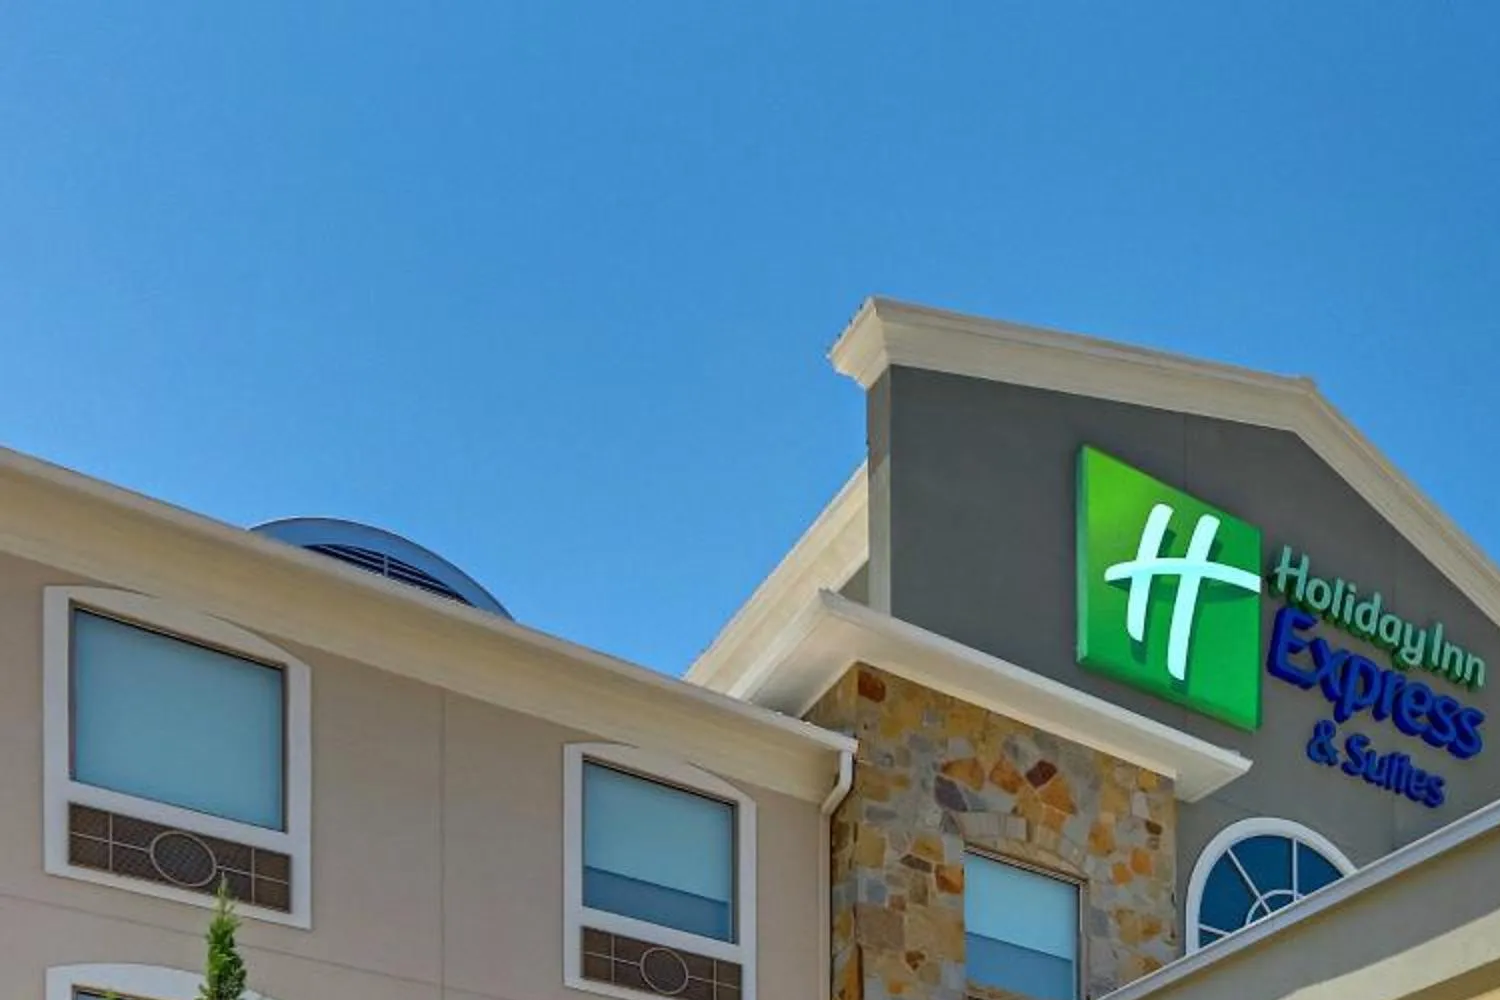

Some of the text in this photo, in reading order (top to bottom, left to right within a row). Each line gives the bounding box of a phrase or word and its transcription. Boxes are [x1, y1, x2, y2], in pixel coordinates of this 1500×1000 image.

[1267, 604, 1486, 760] Express
[1273, 545, 1487, 689] Holiday Inn
[1306, 718, 1447, 809] & Suites
